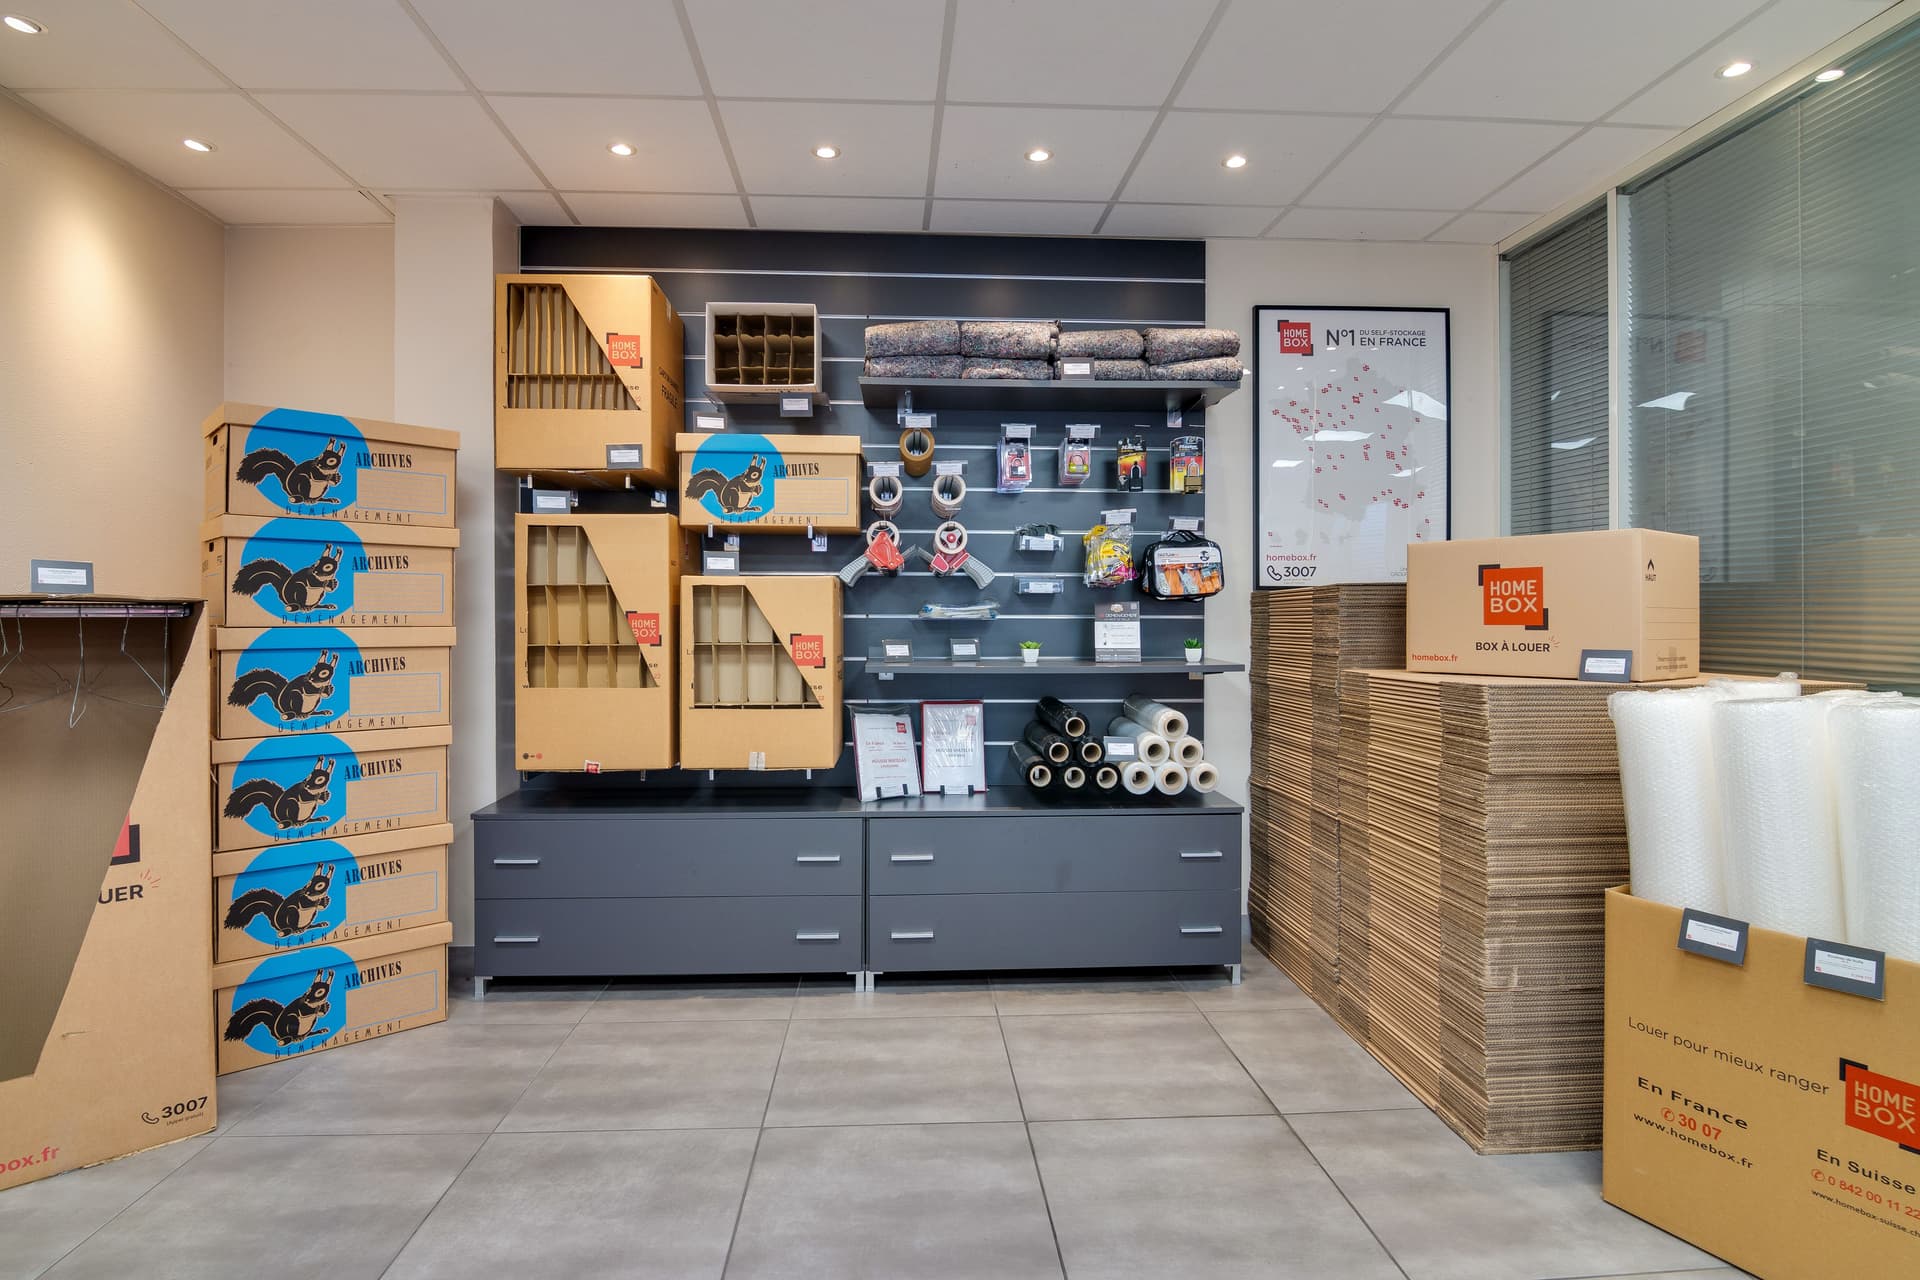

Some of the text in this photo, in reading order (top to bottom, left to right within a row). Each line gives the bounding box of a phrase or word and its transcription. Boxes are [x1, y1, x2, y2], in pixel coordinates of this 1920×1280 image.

[1283, 328, 1308, 338] HOME
[612, 342, 637, 351] HOME
[1283, 338, 1309, 348] BOX
[1360, 338, 1427, 347] EN FRANCE
[612, 350, 637, 360] BOX
[355, 452, 412, 468] ARCHIVES
[773, 462, 820, 478] ARCHIVES
[352, 555, 409, 571] ARCHIVES
[1266, 554, 1317, 562] homebox.fr
[1283, 566, 1317, 578] 3007
[1490, 580, 1537, 596] HOME
[1490, 597, 1538, 613] BOX
[631, 619, 657, 629] HOME
[796, 641, 820, 651] HOME
[1475, 640, 1551, 652] BOX À LOUER
[796, 651, 821, 660] BOX
[1412, 653, 1458, 662] homebox.fr
[348, 656, 406, 675] ARCHIVES
[344, 758, 402, 780] ARCHIVES
[344, 859, 402, 885] ARCHIVES
[98, 884, 144, 905] UER
[344, 960, 402, 989] ARCHIVES
[1628, 1016, 1831, 1095] Louer pour mieux ranger
[1638, 1076, 1748, 1130] En France
[1854, 1080, 1916, 1115] HOME
[162, 1096, 208, 1118] 3007
[1854, 1100, 1916, 1134] BOX
[1678, 1113, 1722, 1141] 30 07
[1633, 1113, 1753, 1169] www.homebox.fr
[1816, 1148, 1916, 1195] En Suisse
[1828, 1175, 1920, 1220] 0 842 00 11 22
[1811, 1188, 1920, 1238] www.homebox-suisse.ch
